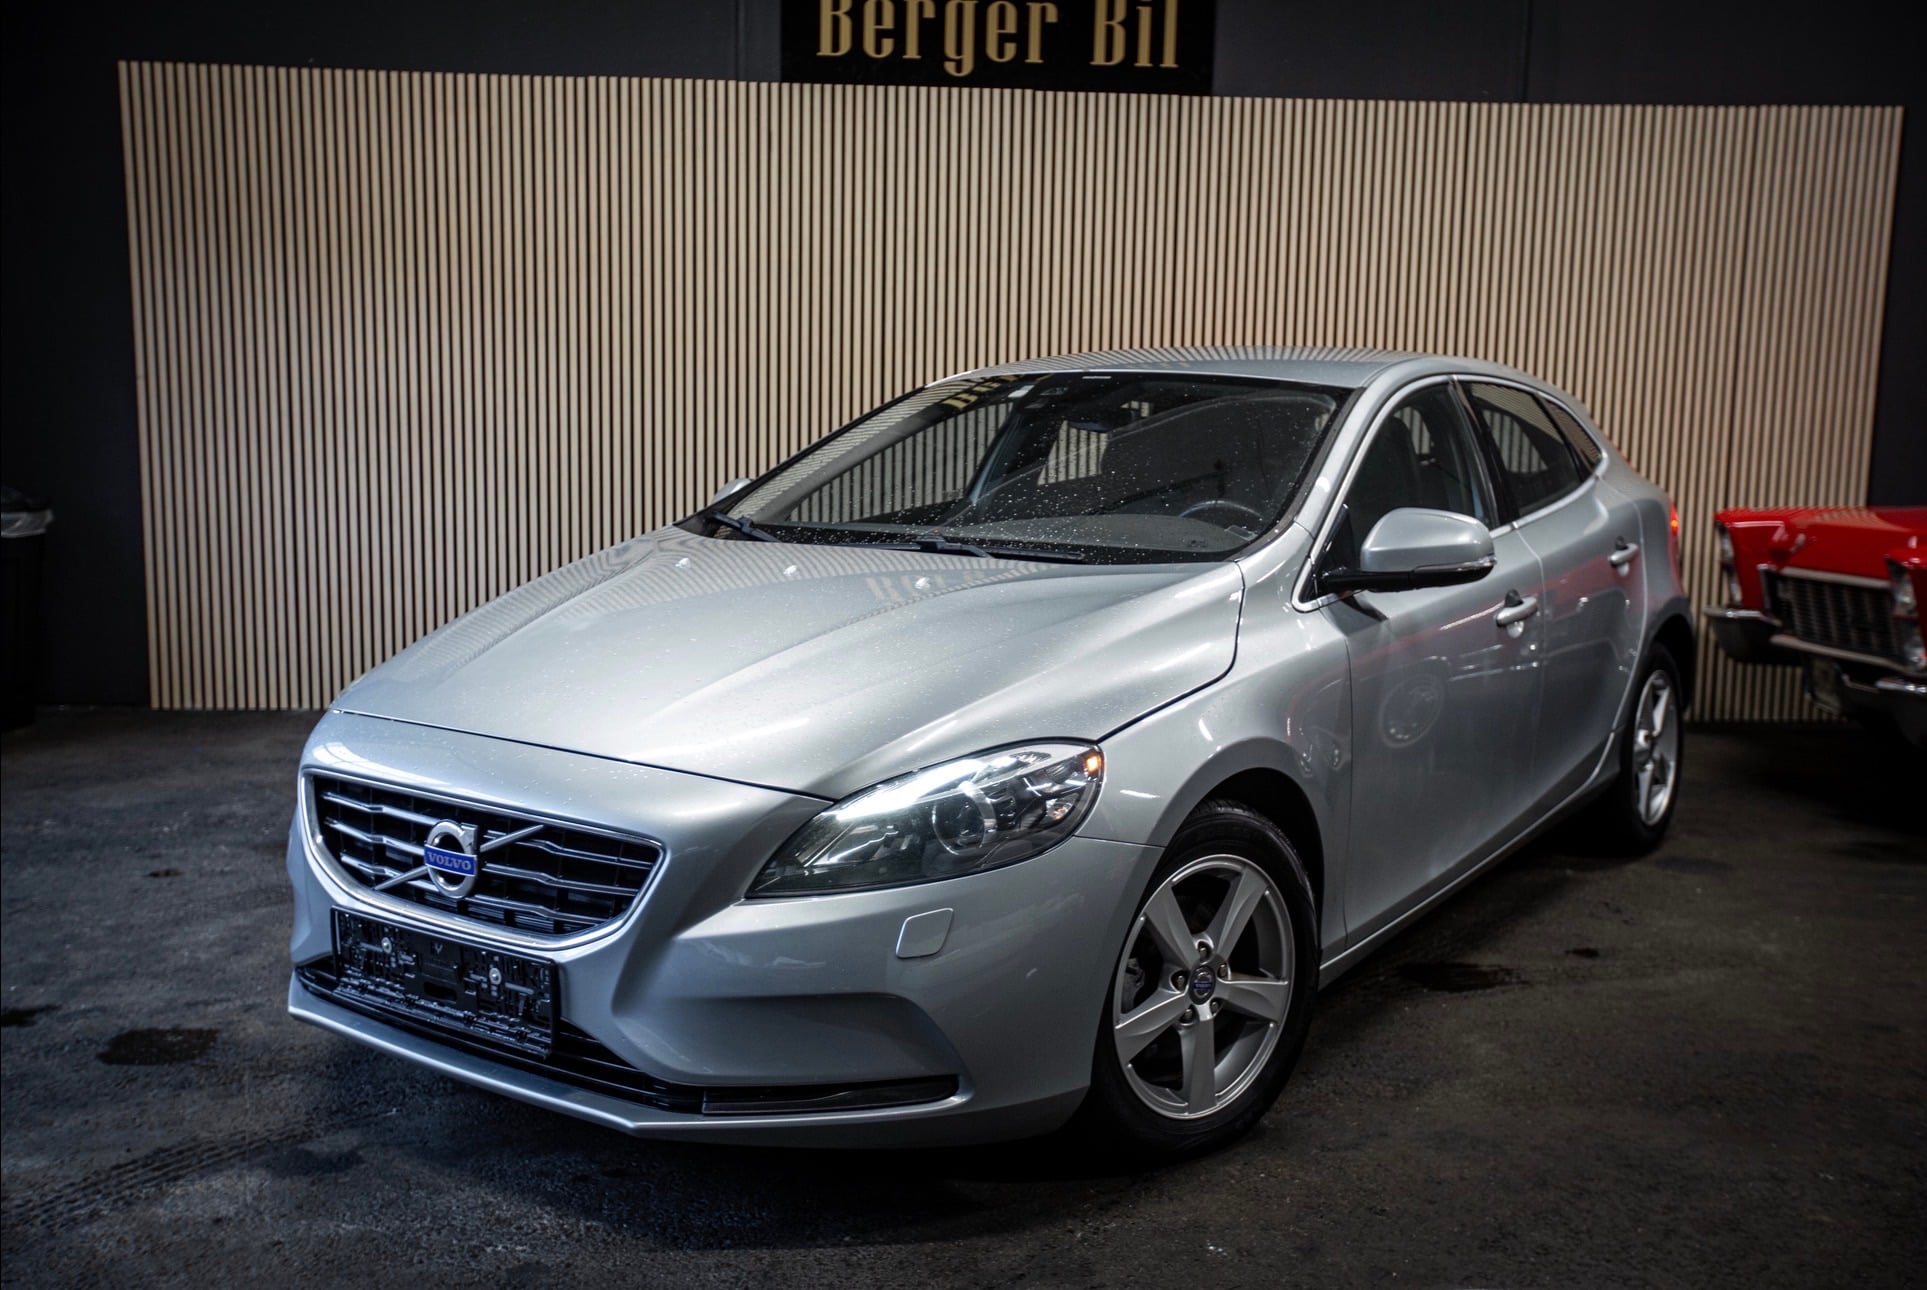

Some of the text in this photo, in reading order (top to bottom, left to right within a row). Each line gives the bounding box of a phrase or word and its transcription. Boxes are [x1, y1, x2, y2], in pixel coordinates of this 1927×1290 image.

[816, 0, 1178, 76] Berger Bil
[426, 851, 472, 870] VOLVO
